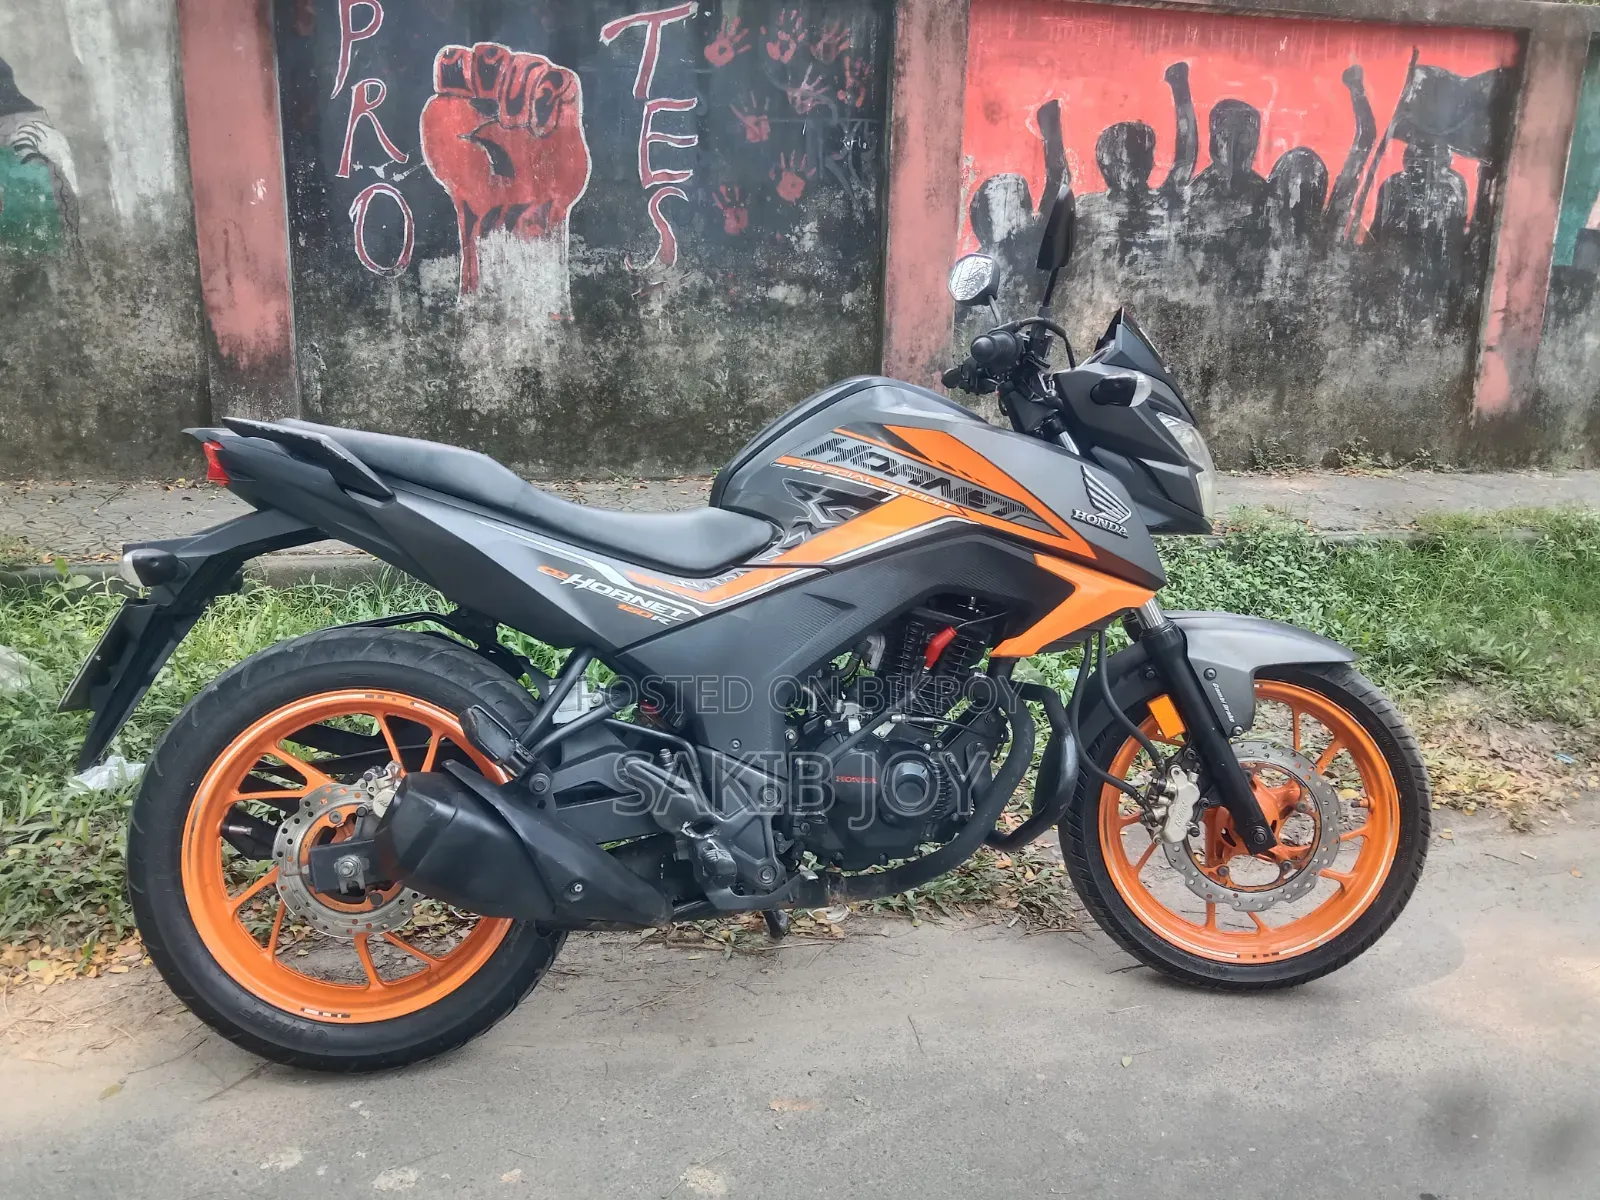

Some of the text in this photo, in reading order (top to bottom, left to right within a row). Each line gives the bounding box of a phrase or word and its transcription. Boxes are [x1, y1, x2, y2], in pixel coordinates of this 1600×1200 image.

[800, 461, 874, 485] SPECIAL
[801, 437, 1032, 520] HORNET
[1071, 508, 1129, 539] HONDA
[560, 573, 690, 618] HORNET
